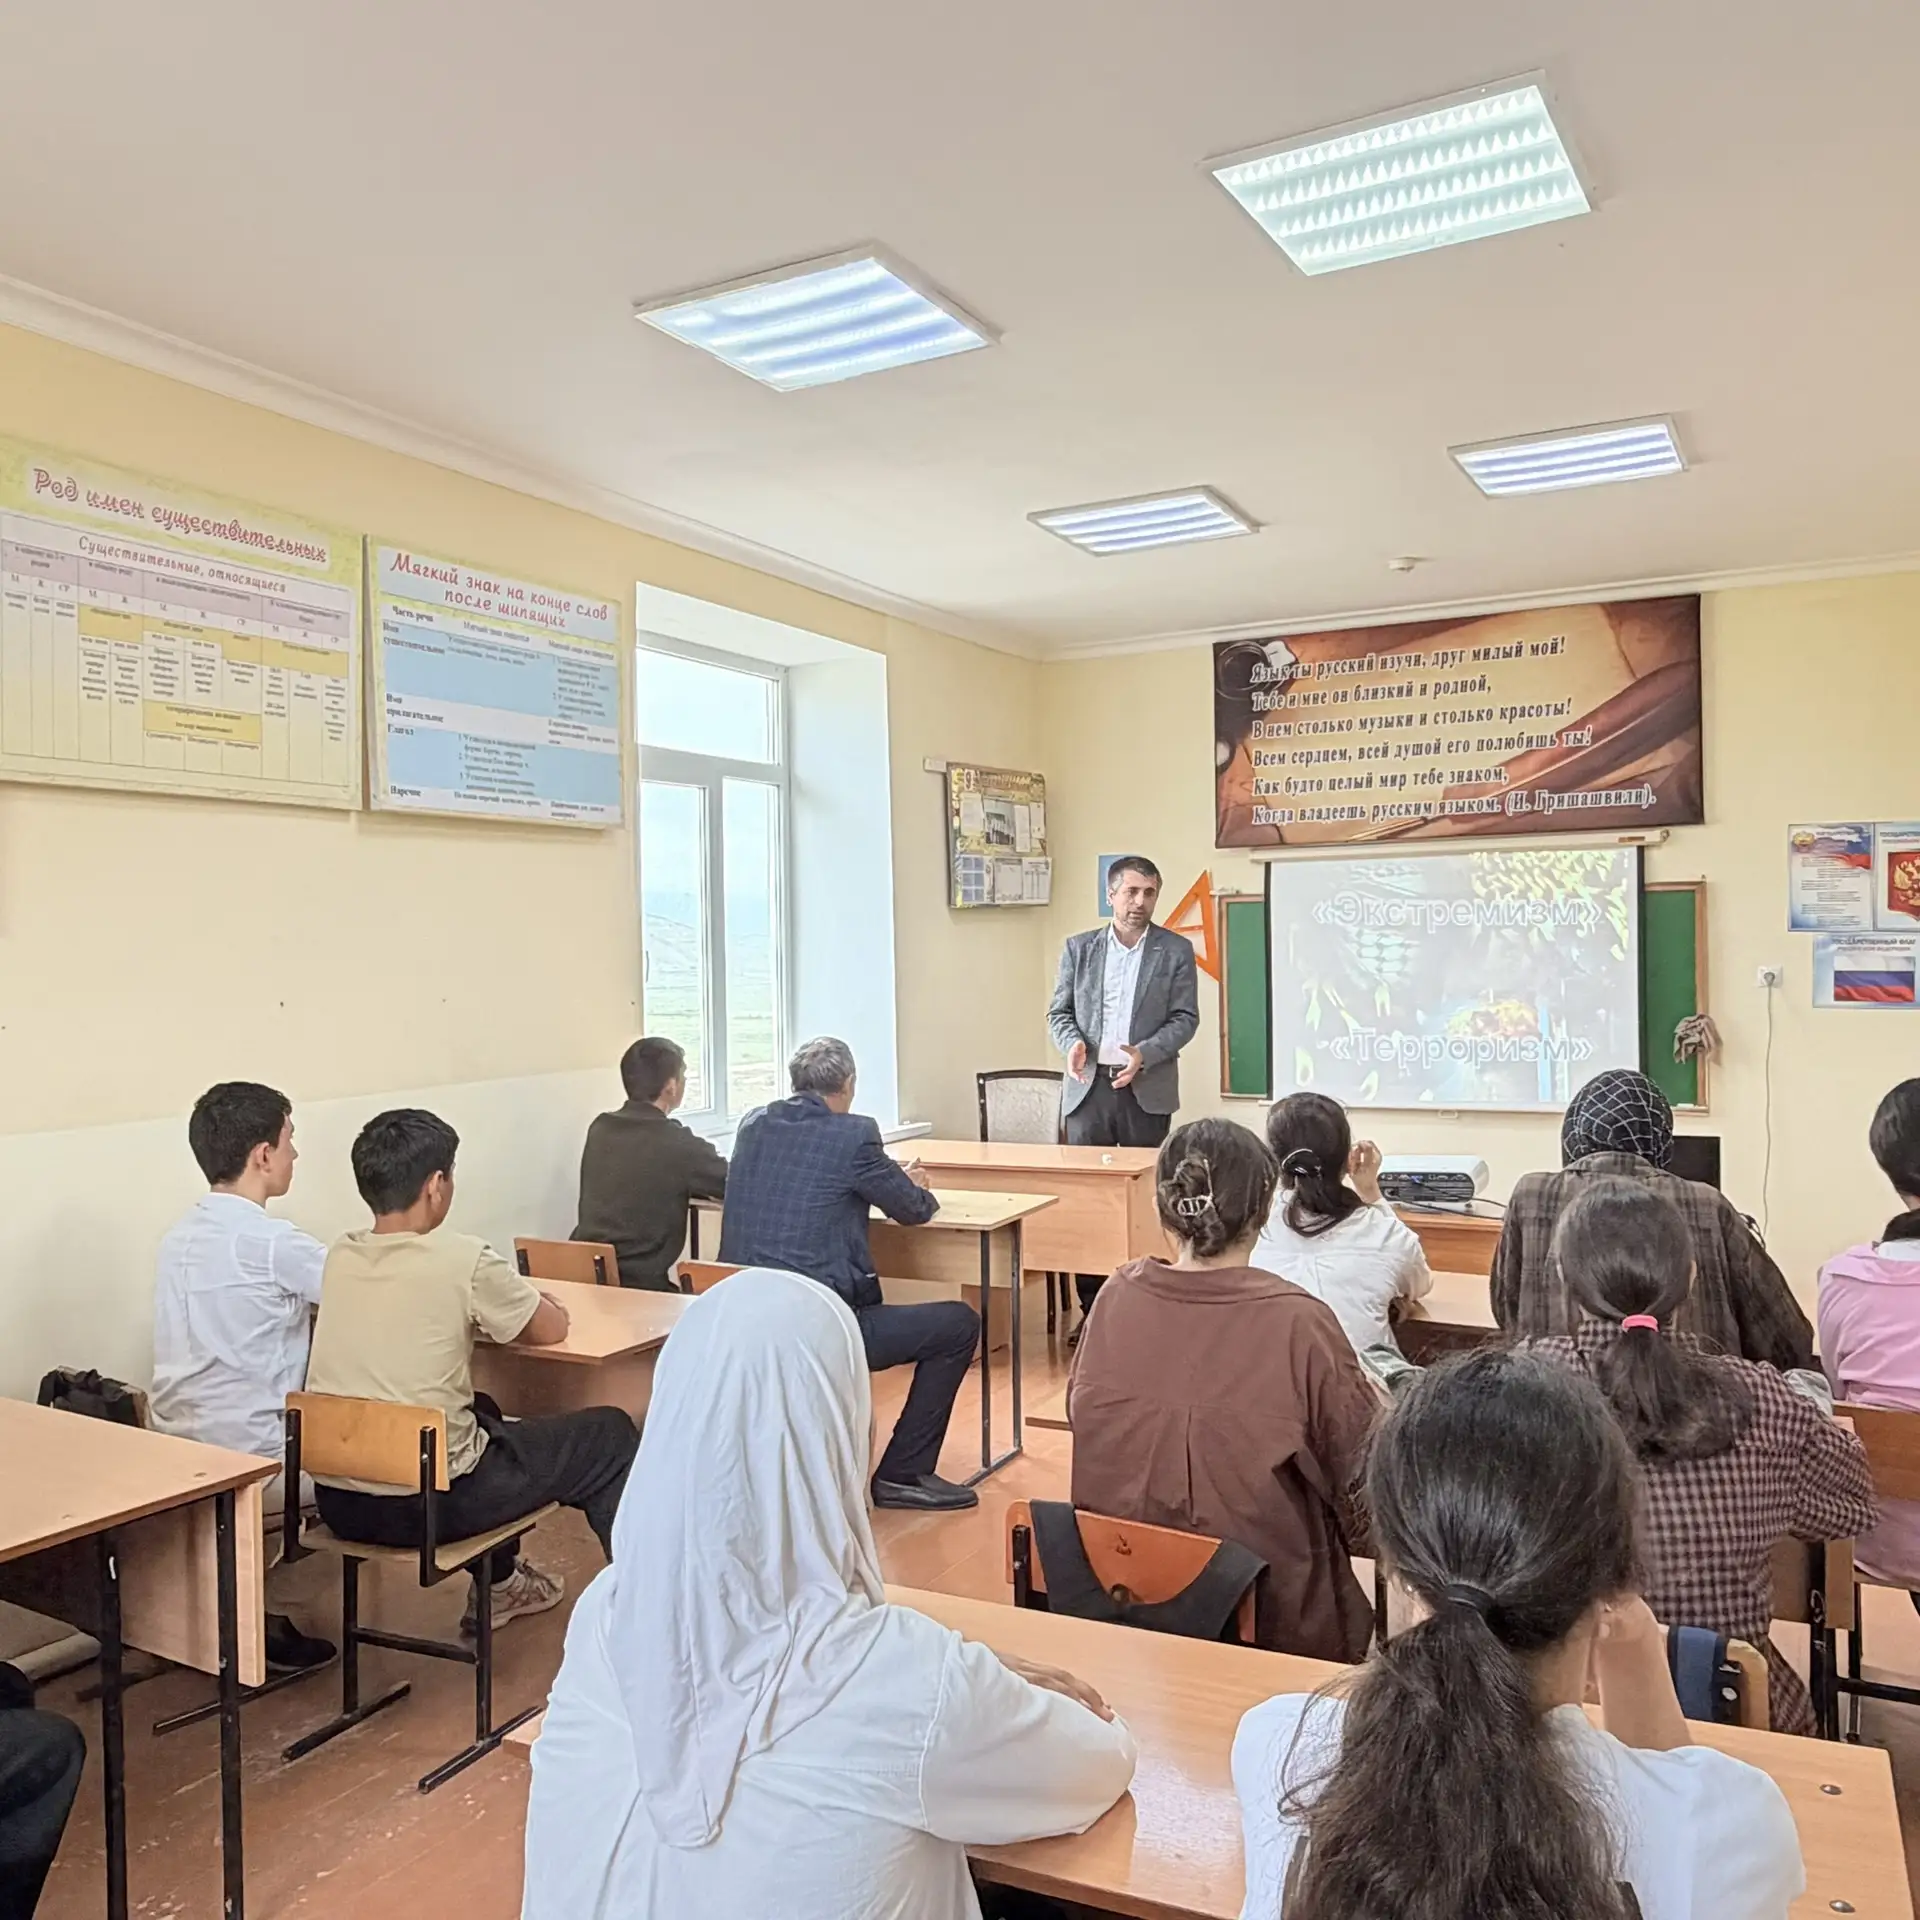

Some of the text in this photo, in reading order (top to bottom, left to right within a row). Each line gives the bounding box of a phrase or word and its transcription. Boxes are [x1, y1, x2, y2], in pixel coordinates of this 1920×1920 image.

[32, 467, 327, 563] Род имен существительных
[78, 535, 204, 577] Существительные,
[207, 566, 287, 594] относящиеся
[389, 552, 609, 622] Мягкий знак на конце слов
[443, 588, 567, 629] после шипящих
[1251, 635, 1566, 682] Язык ты русский изучи, друг милый мой!
[1252, 674, 1492, 710] Тебе и мне он близкий и родной,
[1253, 697, 1572, 738] В нем столько музыки и столько красоты!
[1253, 724, 1593, 768] Всем сердцем, всей душой его полюбишь ты!
[1253, 766, 1509, 797] Как будто целый мир тебе знаком,
[1253, 806, 1294, 825] Когда
[1299, 804, 1367, 823] владеешь
[1371, 800, 1433, 822] русским
[1505, 790, 1530, 816] (И.
[1534, 784, 1656, 814] Гришашвили).
[1312, 889, 1603, 933] «Экстремизм»
[1328, 1028, 1595, 1069] «Терроризм»
